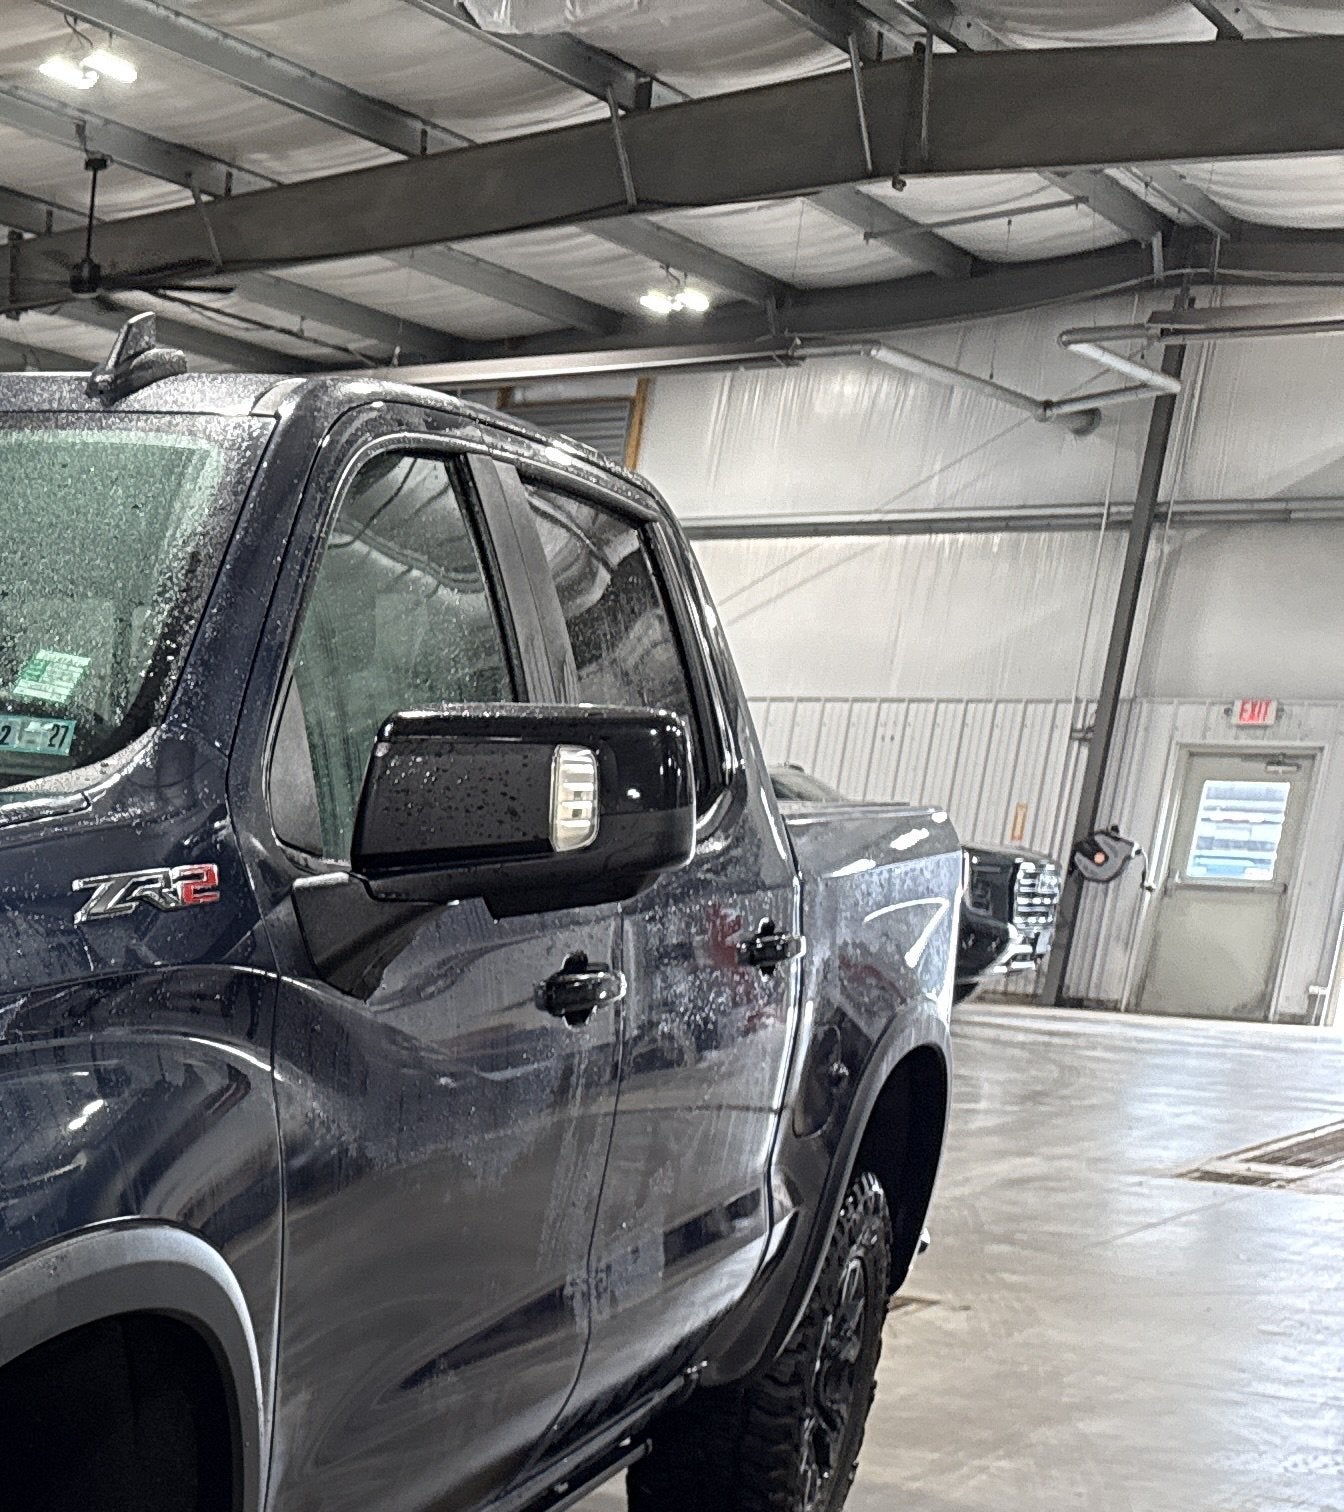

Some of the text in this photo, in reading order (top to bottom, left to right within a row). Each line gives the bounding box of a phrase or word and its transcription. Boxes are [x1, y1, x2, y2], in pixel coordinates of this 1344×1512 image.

[1239, 698, 1273, 722] EXIT
[47, 724, 70, 749] 27
[72, 863, 220, 924] ZR2
